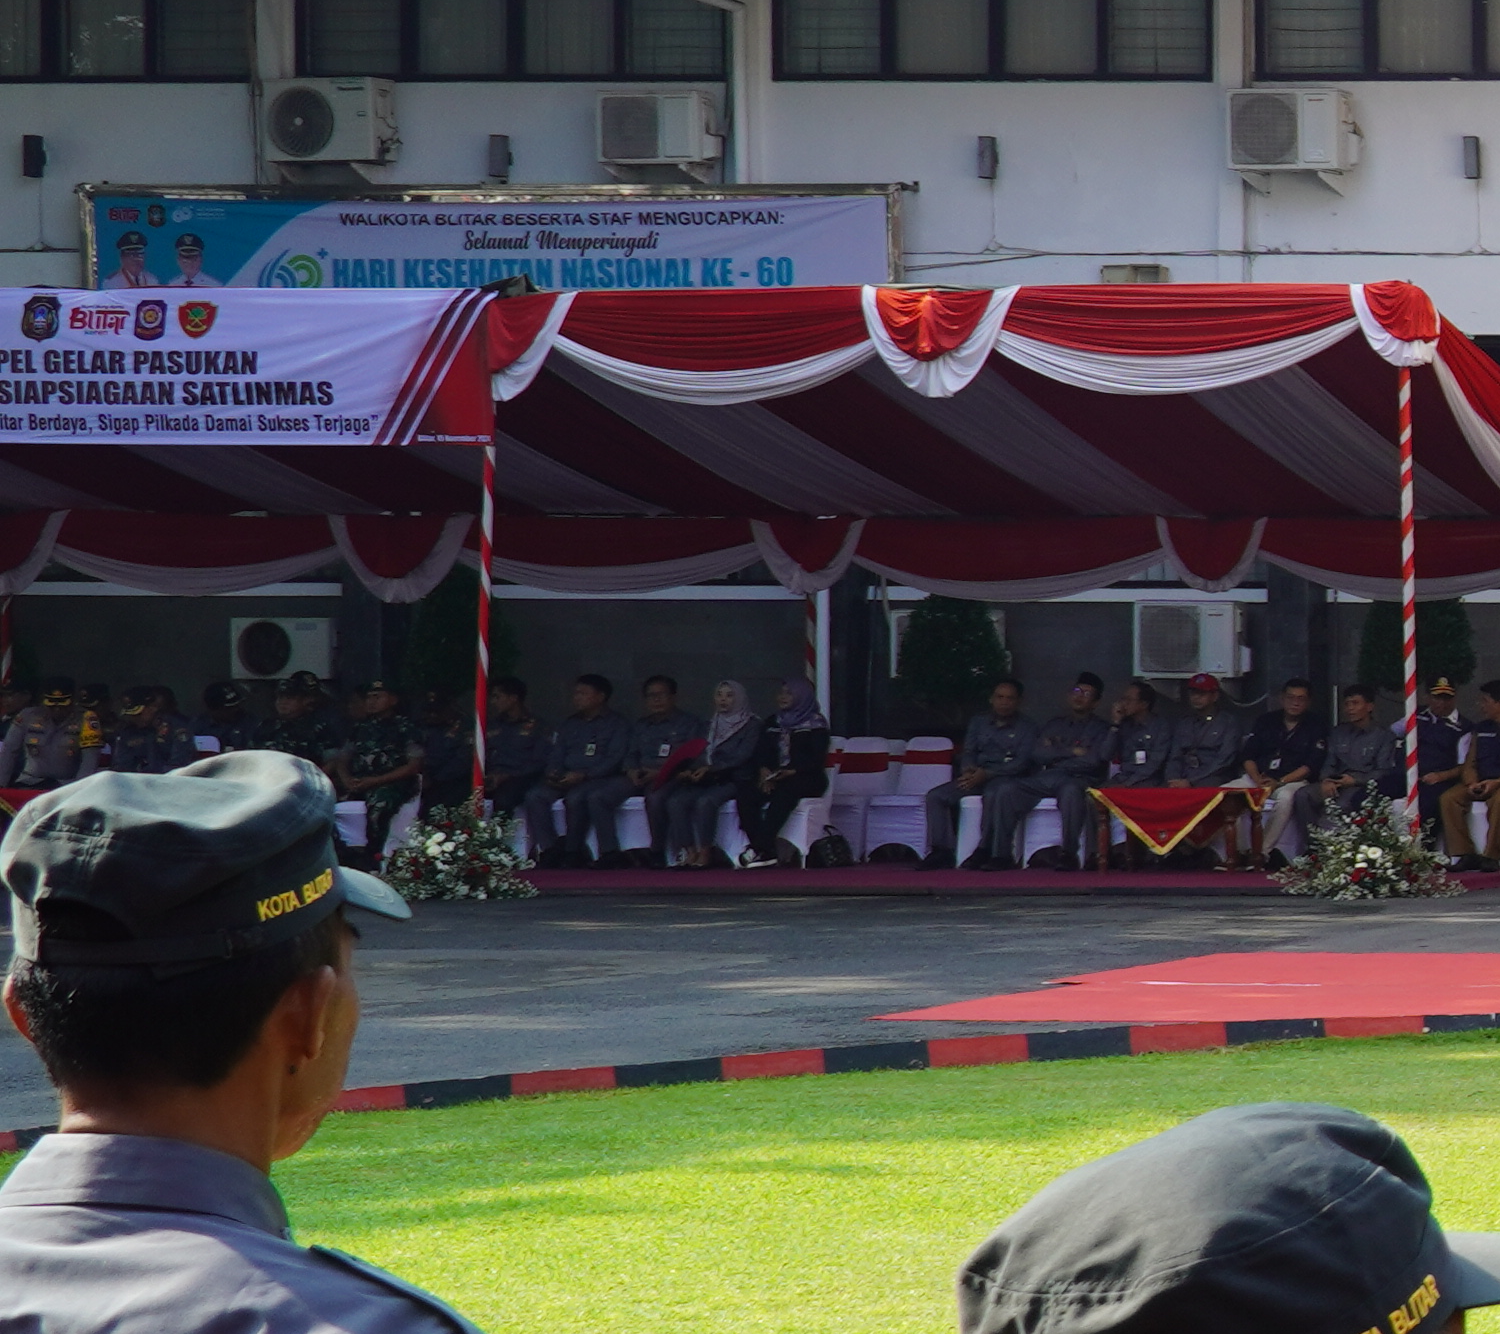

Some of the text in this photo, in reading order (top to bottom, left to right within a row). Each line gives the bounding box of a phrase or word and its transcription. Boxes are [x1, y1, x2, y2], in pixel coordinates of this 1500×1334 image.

[340, 211, 785, 226] WALIKOTA BLITAR BESERTA STAF MENGUCAPKAN:
[464, 230, 659, 257] Selamat Memperingati
[332, 258, 397, 288] HARI
[403, 258, 554, 288] KESEHATAN
[560, 258, 694, 288] NASIONAL
[702, 258, 734, 287] KE
[757, 256, 794, 287] 60
[44, 349, 126, 375] GELAR
[133, 350, 258, 375] PASUKAN
[182, 381, 334, 406] SATLINMAS
[29, 414, 93, 435] Berdaya,
[98, 414, 140, 435] Sigap
[144, 414, 200, 432] Pilkada
[205, 414, 253, 432] Damai
[257, 414, 311, 432] Sukses
[257, 890, 300, 922] KOTA
